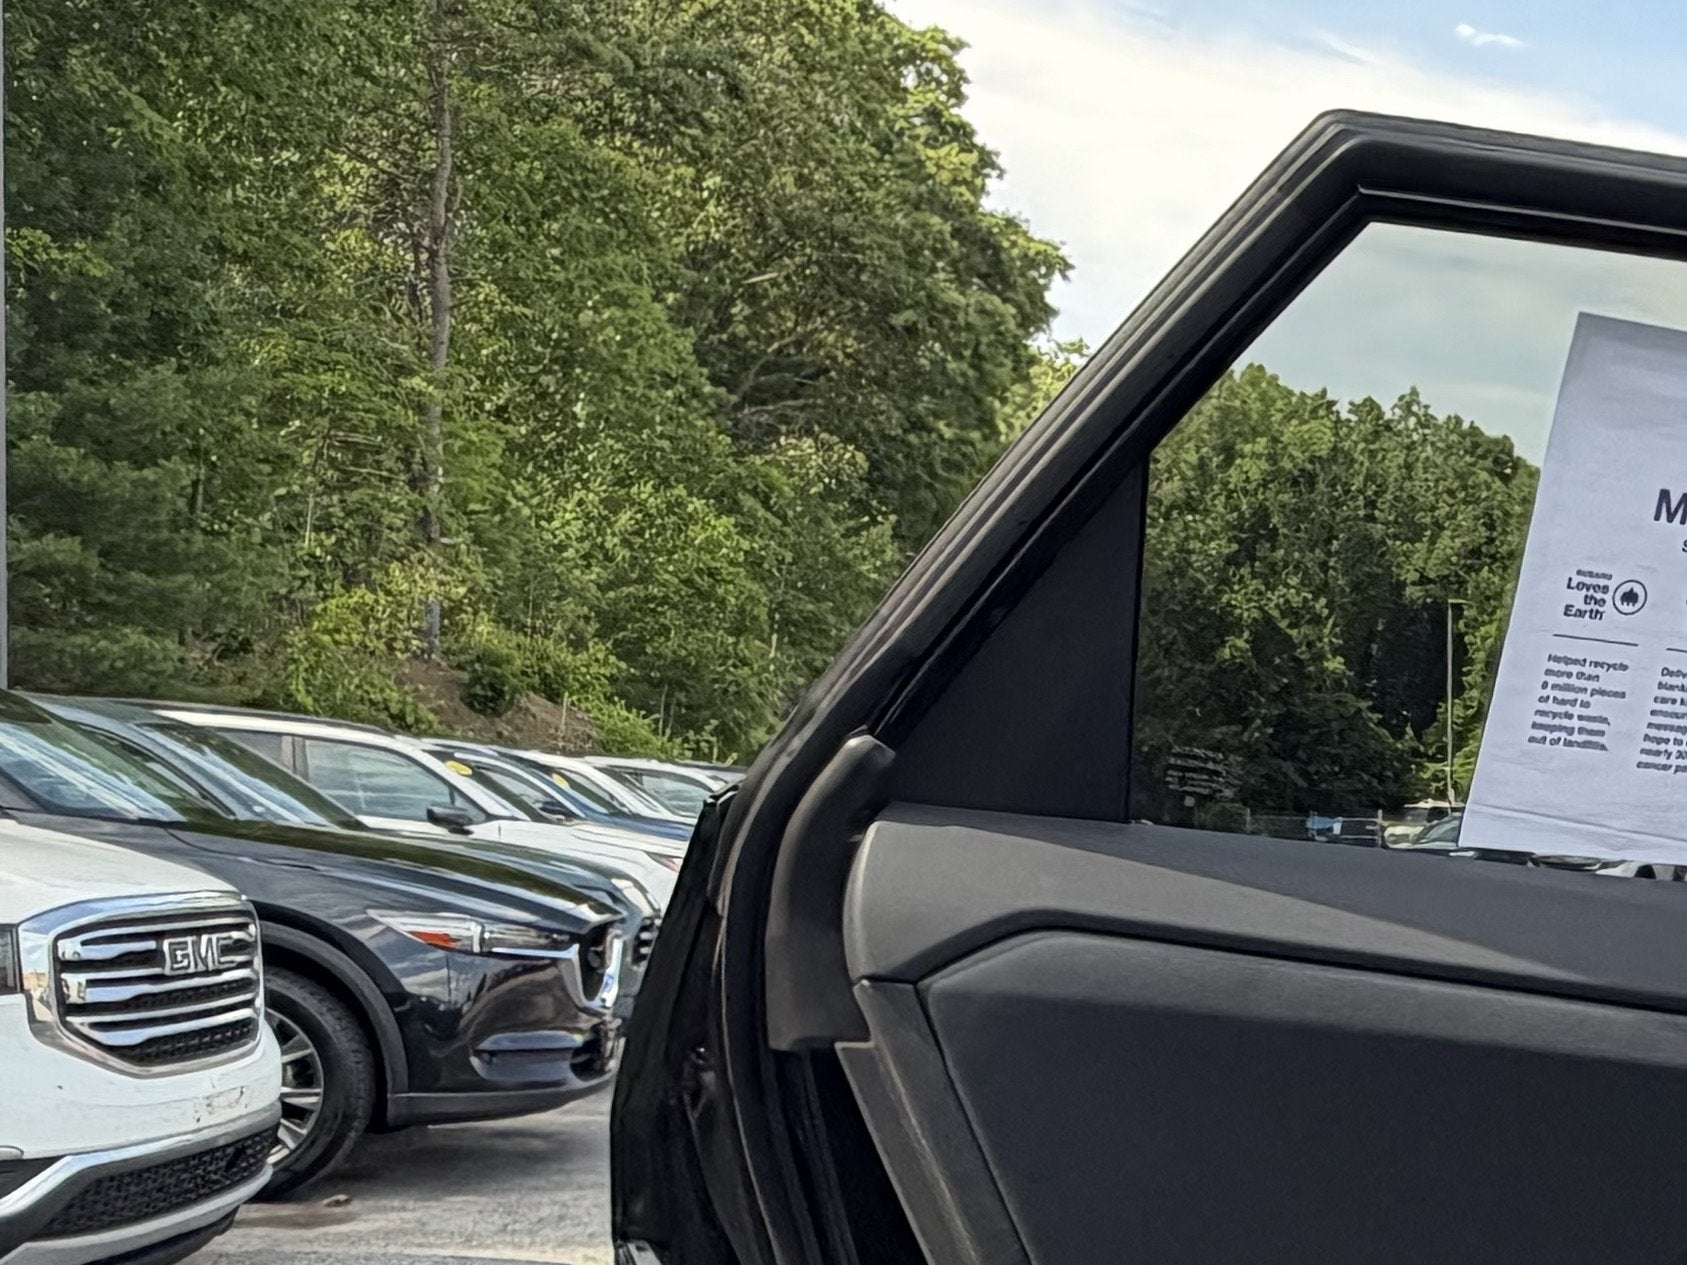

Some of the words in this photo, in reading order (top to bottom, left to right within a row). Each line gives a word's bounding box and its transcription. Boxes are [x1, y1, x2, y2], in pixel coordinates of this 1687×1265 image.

[1566, 577, 1610, 594] Loves
[1583, 592, 1606, 607] the
[1563, 604, 1605, 621] Earth
[163, 931, 243, 976] GMC
